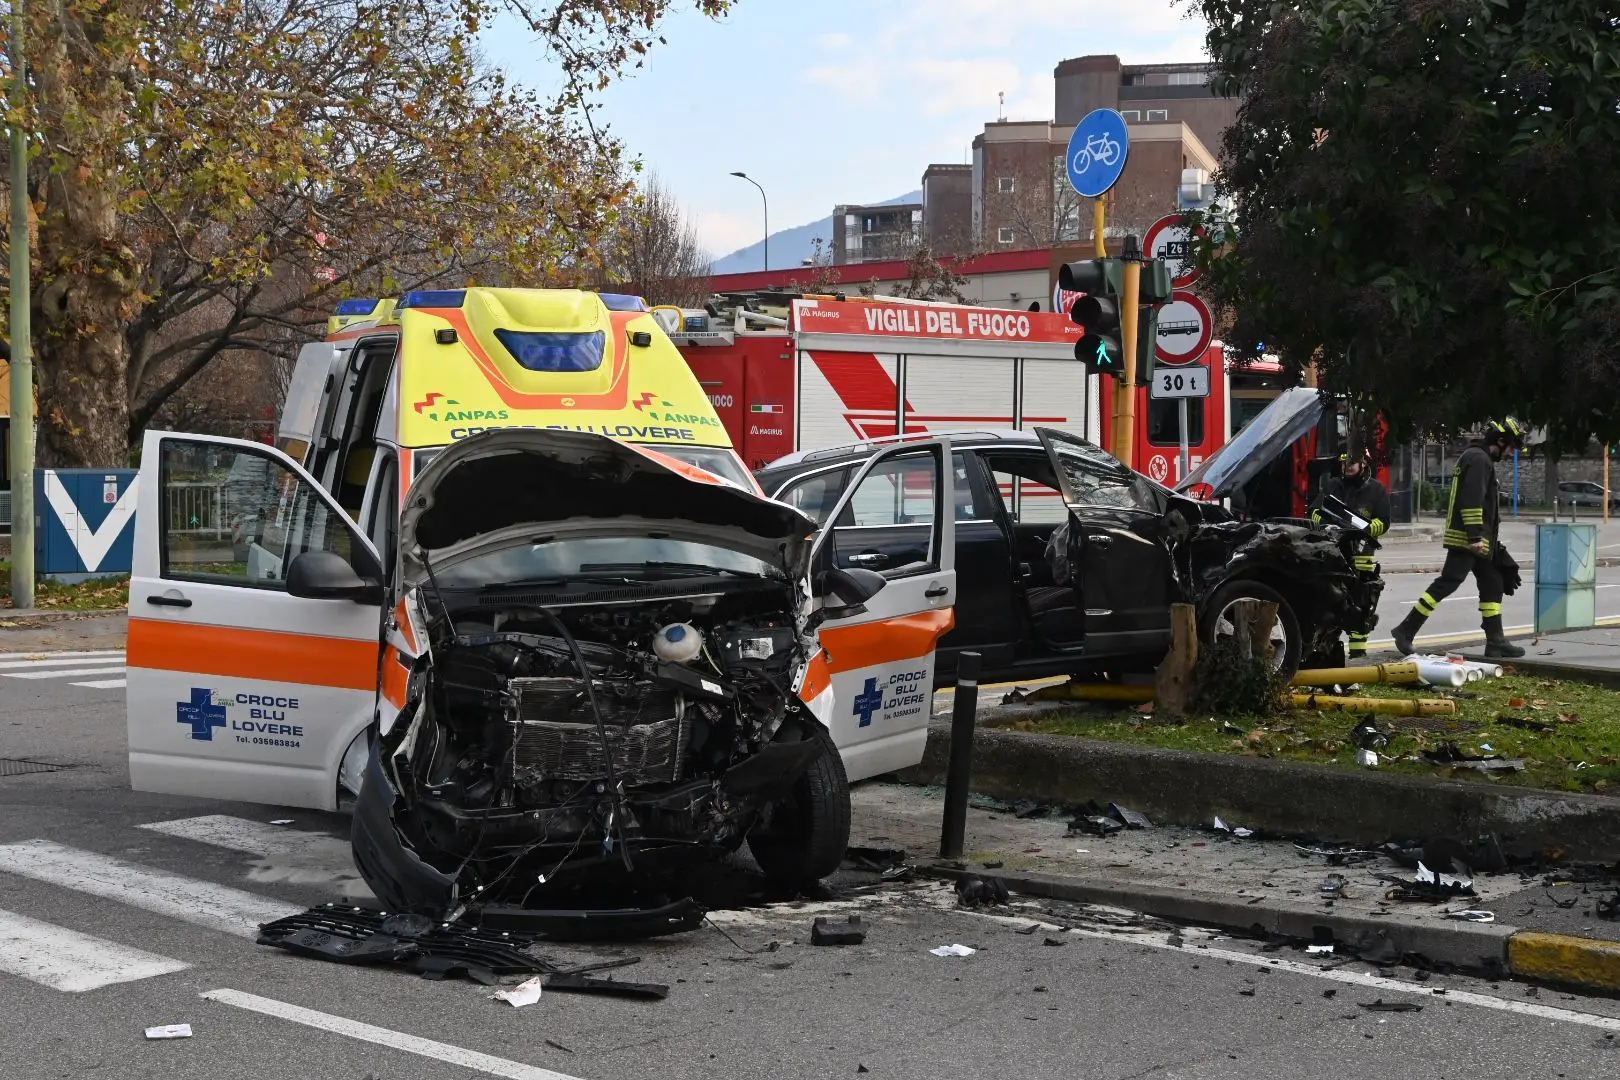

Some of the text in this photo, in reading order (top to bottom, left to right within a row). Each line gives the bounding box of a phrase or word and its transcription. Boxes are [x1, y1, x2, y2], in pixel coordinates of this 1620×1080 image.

[1170, 243, 1183, 254] 26
[811, 310, 840, 319] MAGIRUS
[863, 307, 1031, 338] VIGILI DEL FUOCO
[1163, 374, 1197, 391] 30 t
[706, 394, 733, 408] UOCO
[444, 410, 509, 422] ANPAS
[664, 412, 720, 427] ANPAS
[602, 425, 696, 441] LOVERE
[759, 428, 783, 436] MAGIRUS
[889, 669, 927, 685] CROCE
[895, 683, 918, 695] BLU
[235, 693, 299, 709] CROCE
[883, 693, 925, 710] LOVERE
[250, 708, 285, 721] BLU
[232, 720, 304, 737] LOVERE
[235, 736, 301, 748] Tel. 035983834
